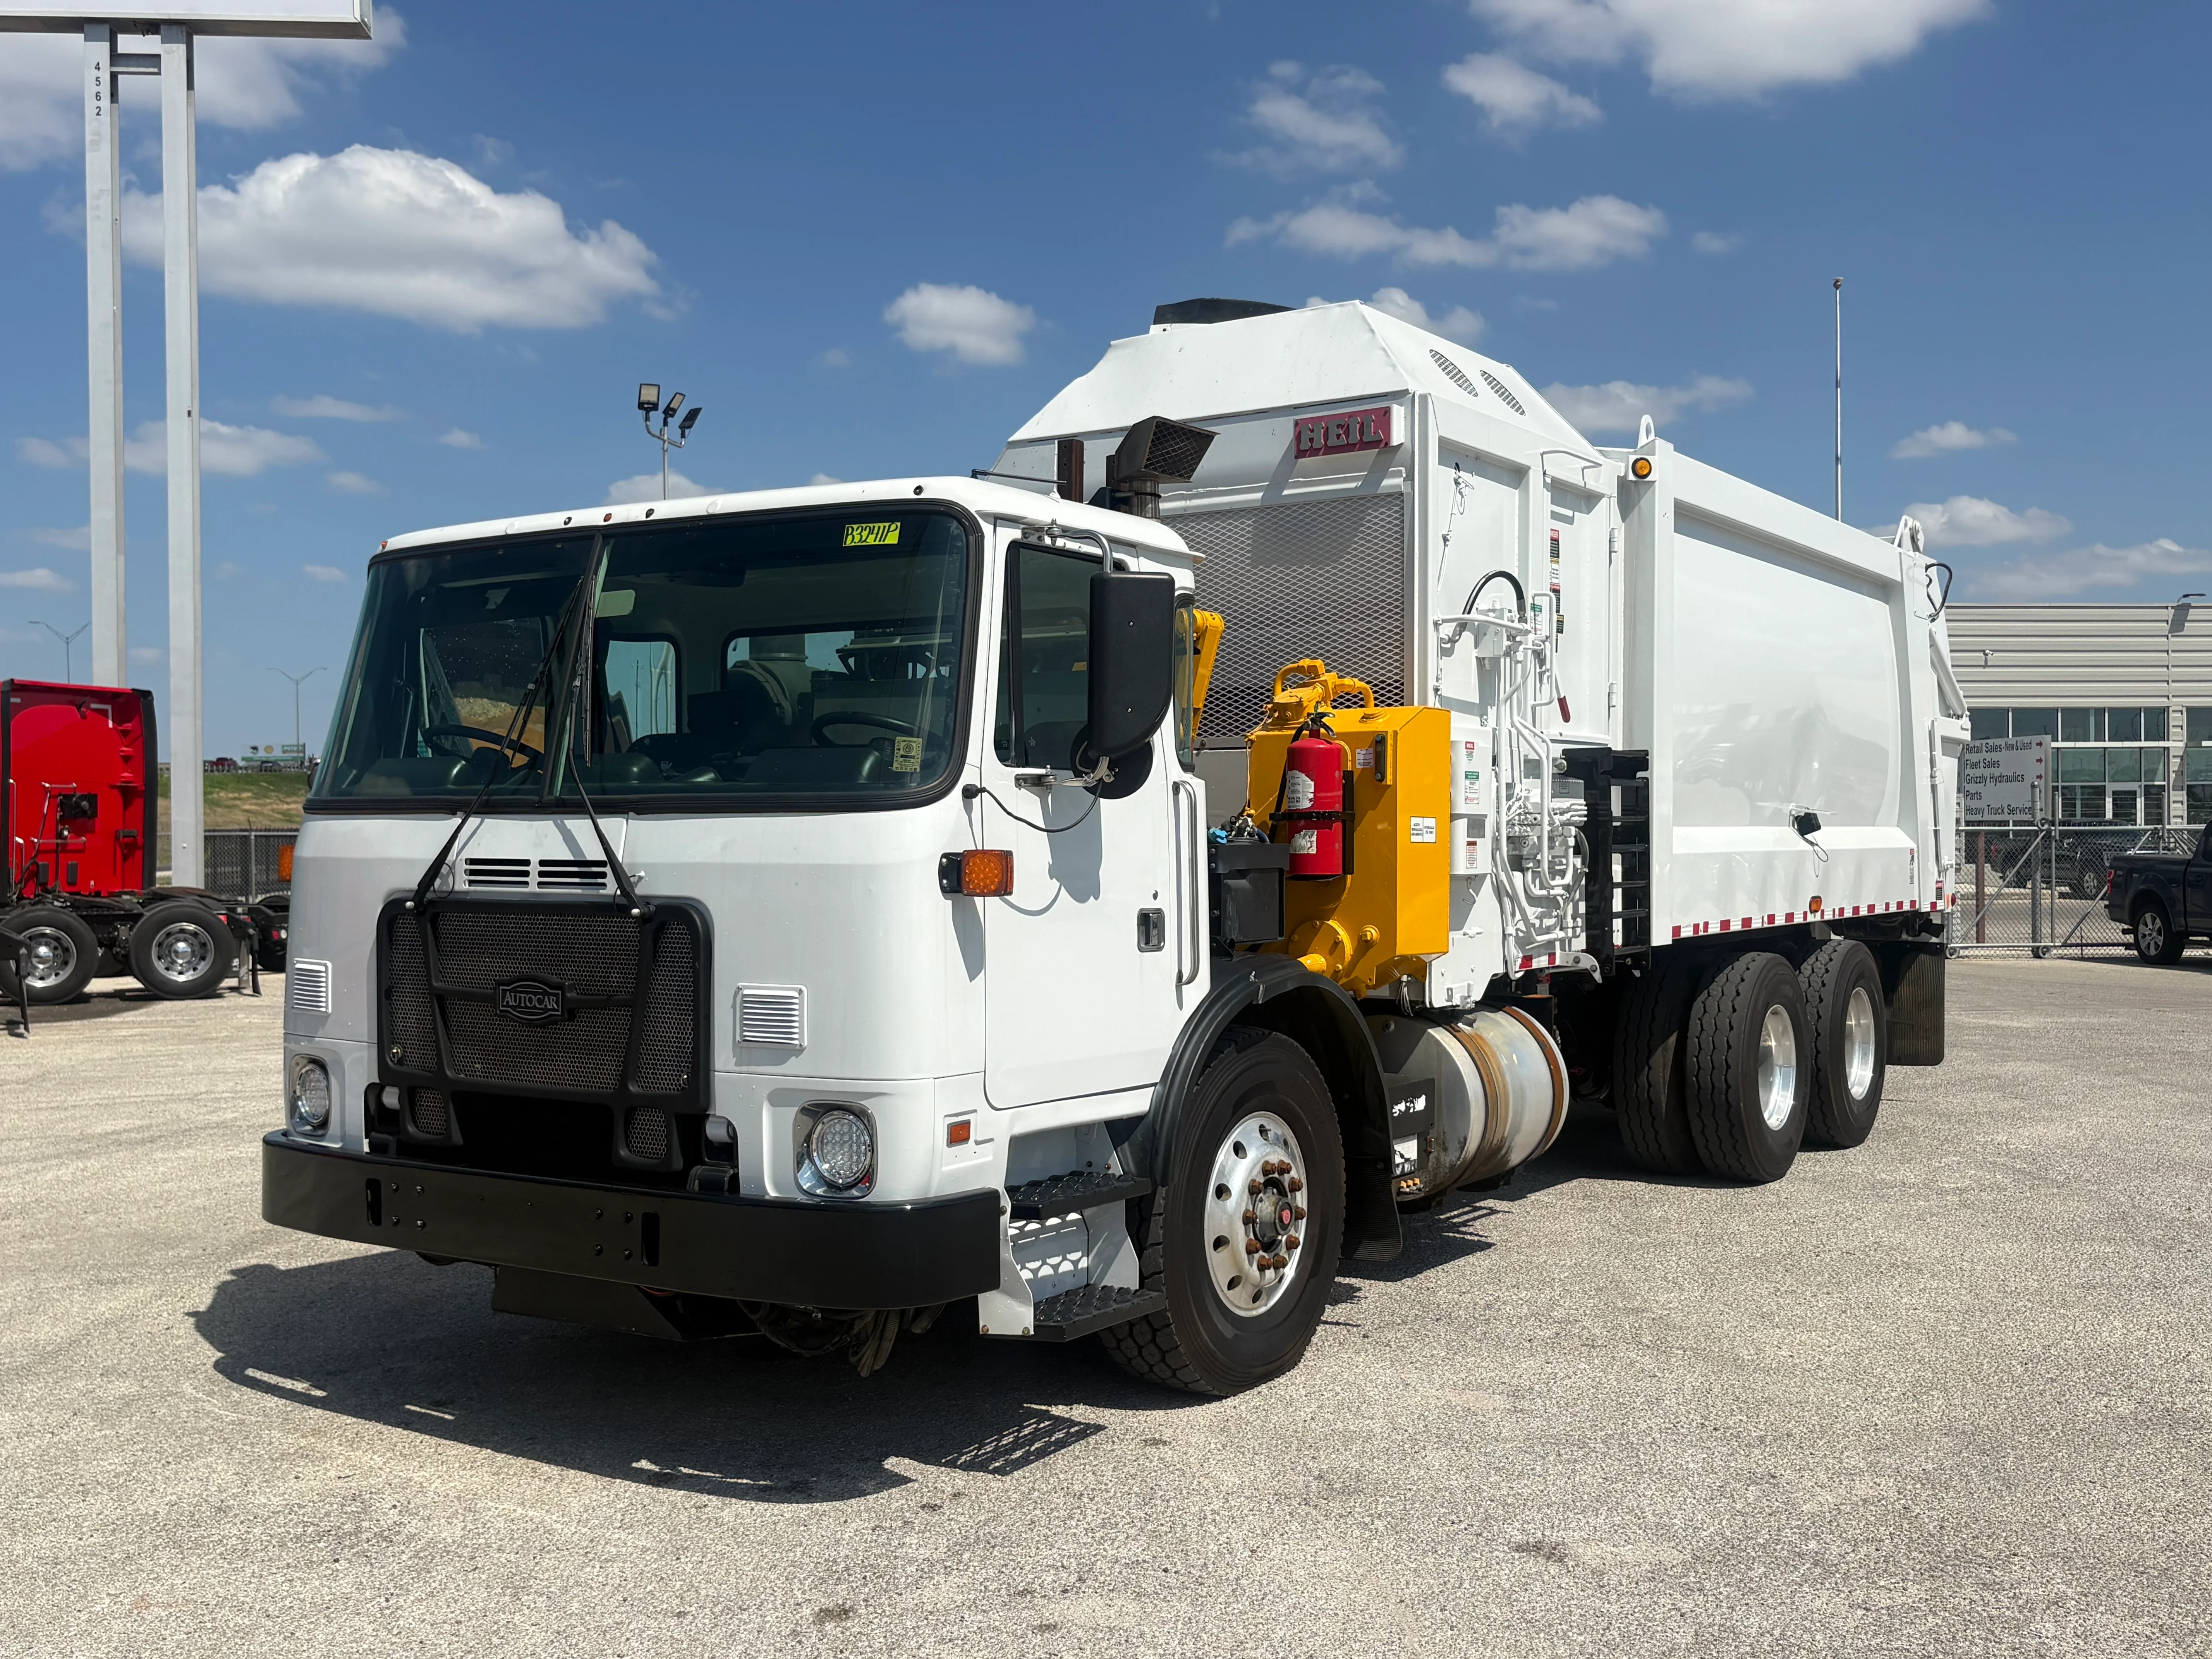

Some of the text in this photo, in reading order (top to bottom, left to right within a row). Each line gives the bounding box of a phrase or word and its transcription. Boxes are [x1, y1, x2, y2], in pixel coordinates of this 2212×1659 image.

[1300, 414, 1384, 450] HEIL
[1965, 742, 1983, 754] Retail
[2020, 739, 2032, 750] Used
[1966, 757, 2000, 769] Fleet Sales
[1966, 772, 2025, 787] Grizzly Hydraulics
[1966, 790, 1982, 800] Parts
[1966, 803, 2032, 818] Heavy Truck Service
[502, 991, 558, 1009] AUTOCAR
